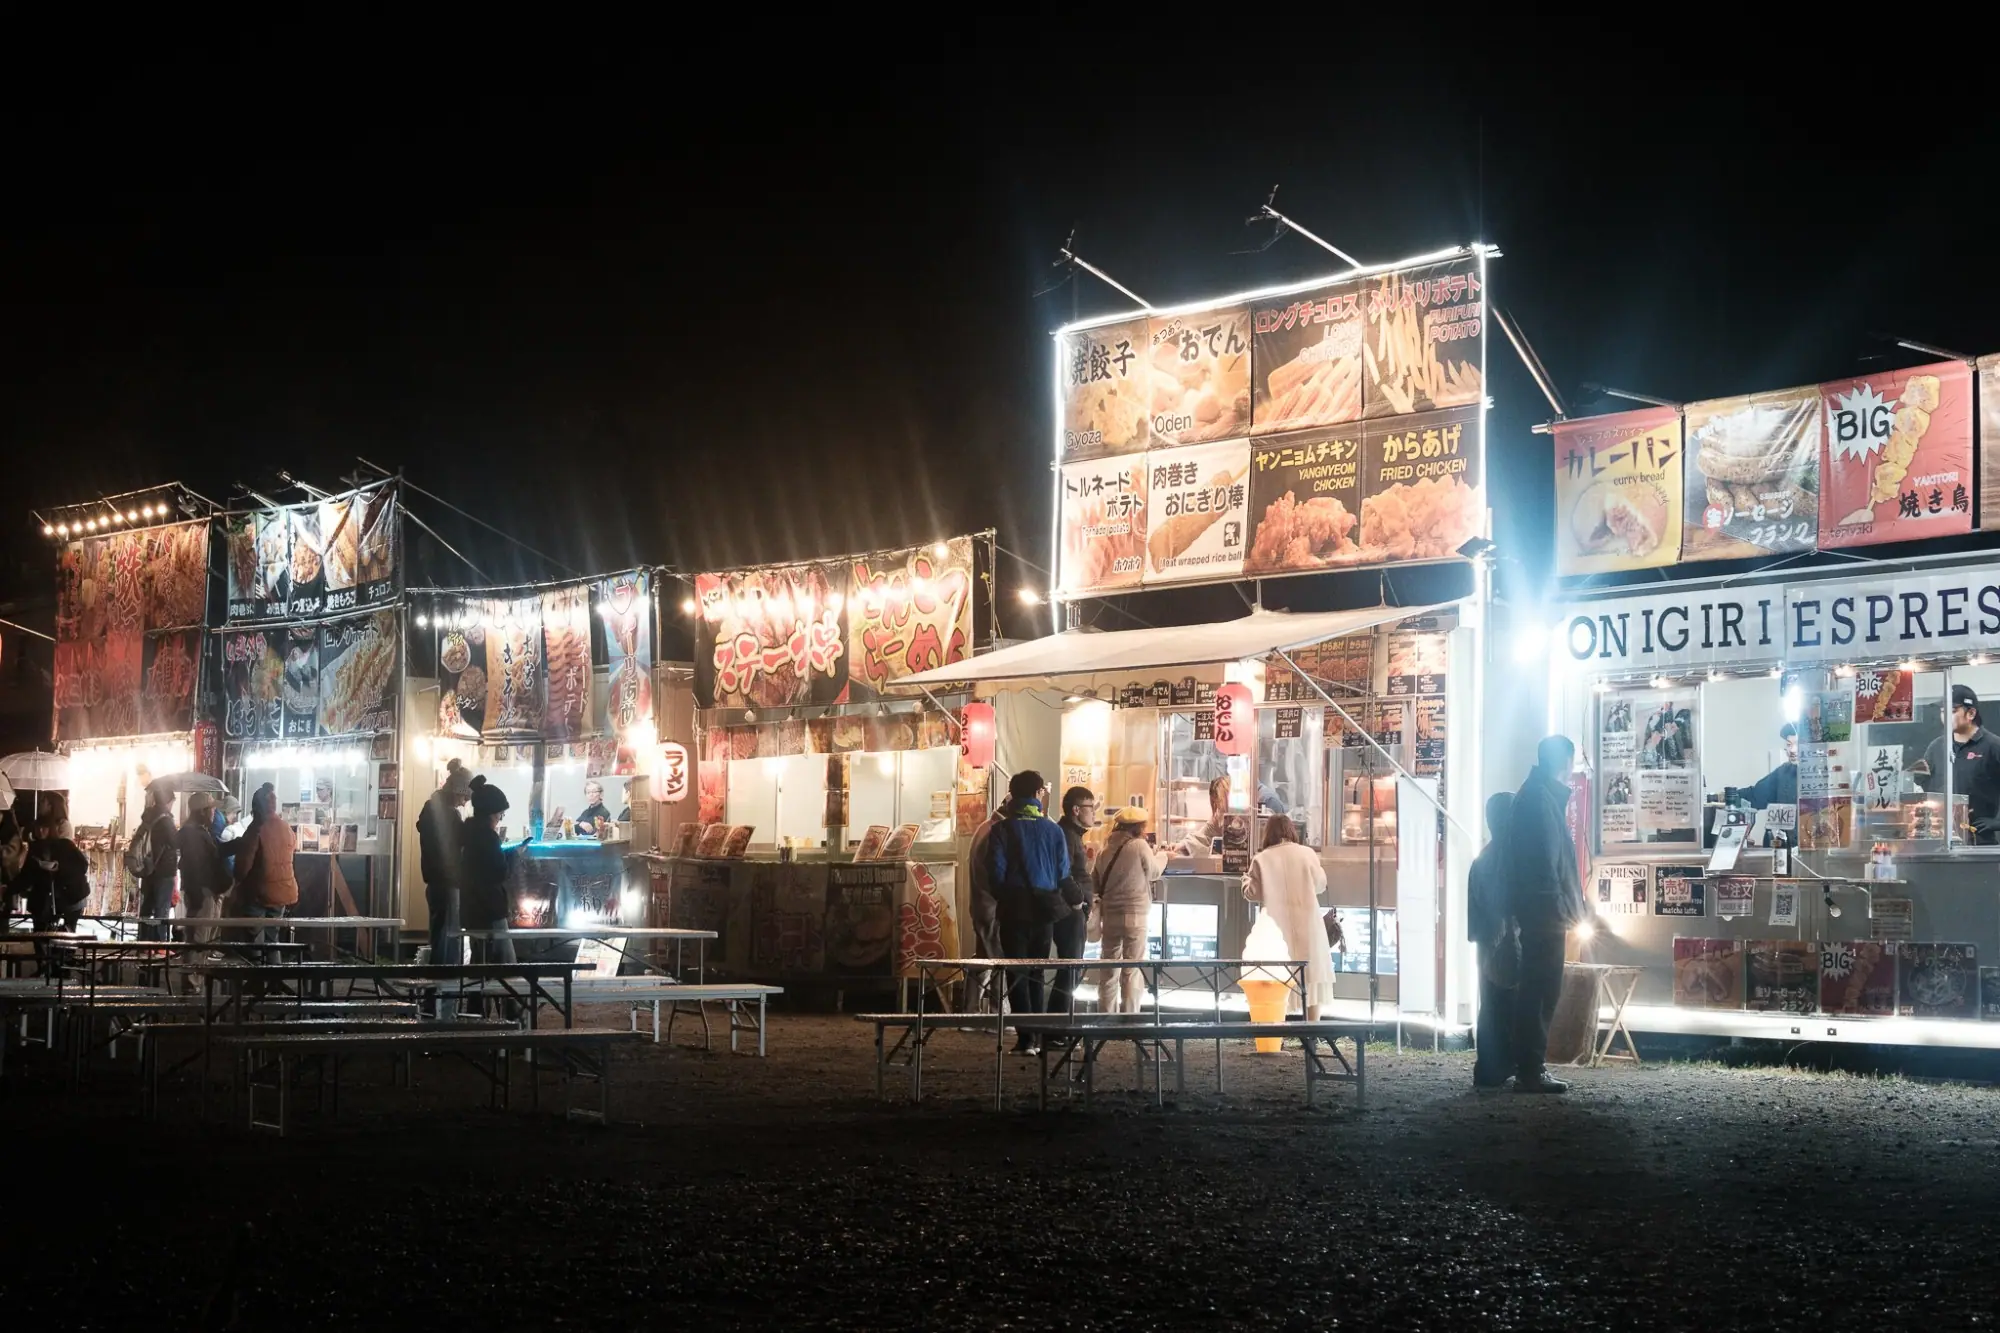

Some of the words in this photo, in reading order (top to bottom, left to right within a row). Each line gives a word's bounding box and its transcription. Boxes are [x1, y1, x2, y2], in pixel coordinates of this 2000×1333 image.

[1367, 272, 1481, 314] ふりふりポテト
[1255, 293, 1360, 334] ロングチュロス
[1429, 301, 1481, 325] FURIFURI
[1152, 319, 1183, 347] あつあつ
[1429, 319, 1481, 344] POTATO
[1071, 340, 1136, 386] 焼餃子
[1154, 414, 1192, 434] Oden
[1837, 405, 1890, 445] BIG
[1065, 430, 1102, 449] Gyoza
[1383, 424, 1462, 463] からあげ
[1255, 440, 1357, 472] ヤンニョムチキン
[1564, 437, 1677, 480] カレーパン
[1153, 461, 1198, 490] 肉巻き
[1298, 461, 1356, 481] YANGNYEOM
[1380, 464, 1414, 482] FRIED
[1416, 458, 1467, 478] CHICKEN
[1613, 475, 1638, 486] curry
[1639, 470, 1666, 483] bread
[1066, 471, 1132, 499] トルネード
[1313, 476, 1356, 492] CHICKEN
[1106, 495, 1144, 518] ポテト
[1165, 484, 1245, 517] おにぎり棒
[1899, 483, 1969, 518] 焼き鳥
[1750, 522, 1815, 545] フランク
[1113, 556, 1142, 572] ホクホク
[369, 581, 394, 600] チュロス
[1792, 584, 2000, 647] ESPRES
[1567, 598, 1772, 661] ONIGIRI
[1152, 687, 1169, 696] おでん
[1858, 678, 1879, 691] BIG
[1215, 693, 1234, 742] おでん
[665, 750, 684, 796] ラーメン
[1872, 748, 1895, 810] 生ビール
[1768, 808, 1794, 823] SAKE
[1599, 867, 1646, 879] ESPRESSO
[1665, 880, 1690, 895] 売切
[1718, 883, 1753, 899] ご注文
[1823, 952, 1850, 970] BIG
